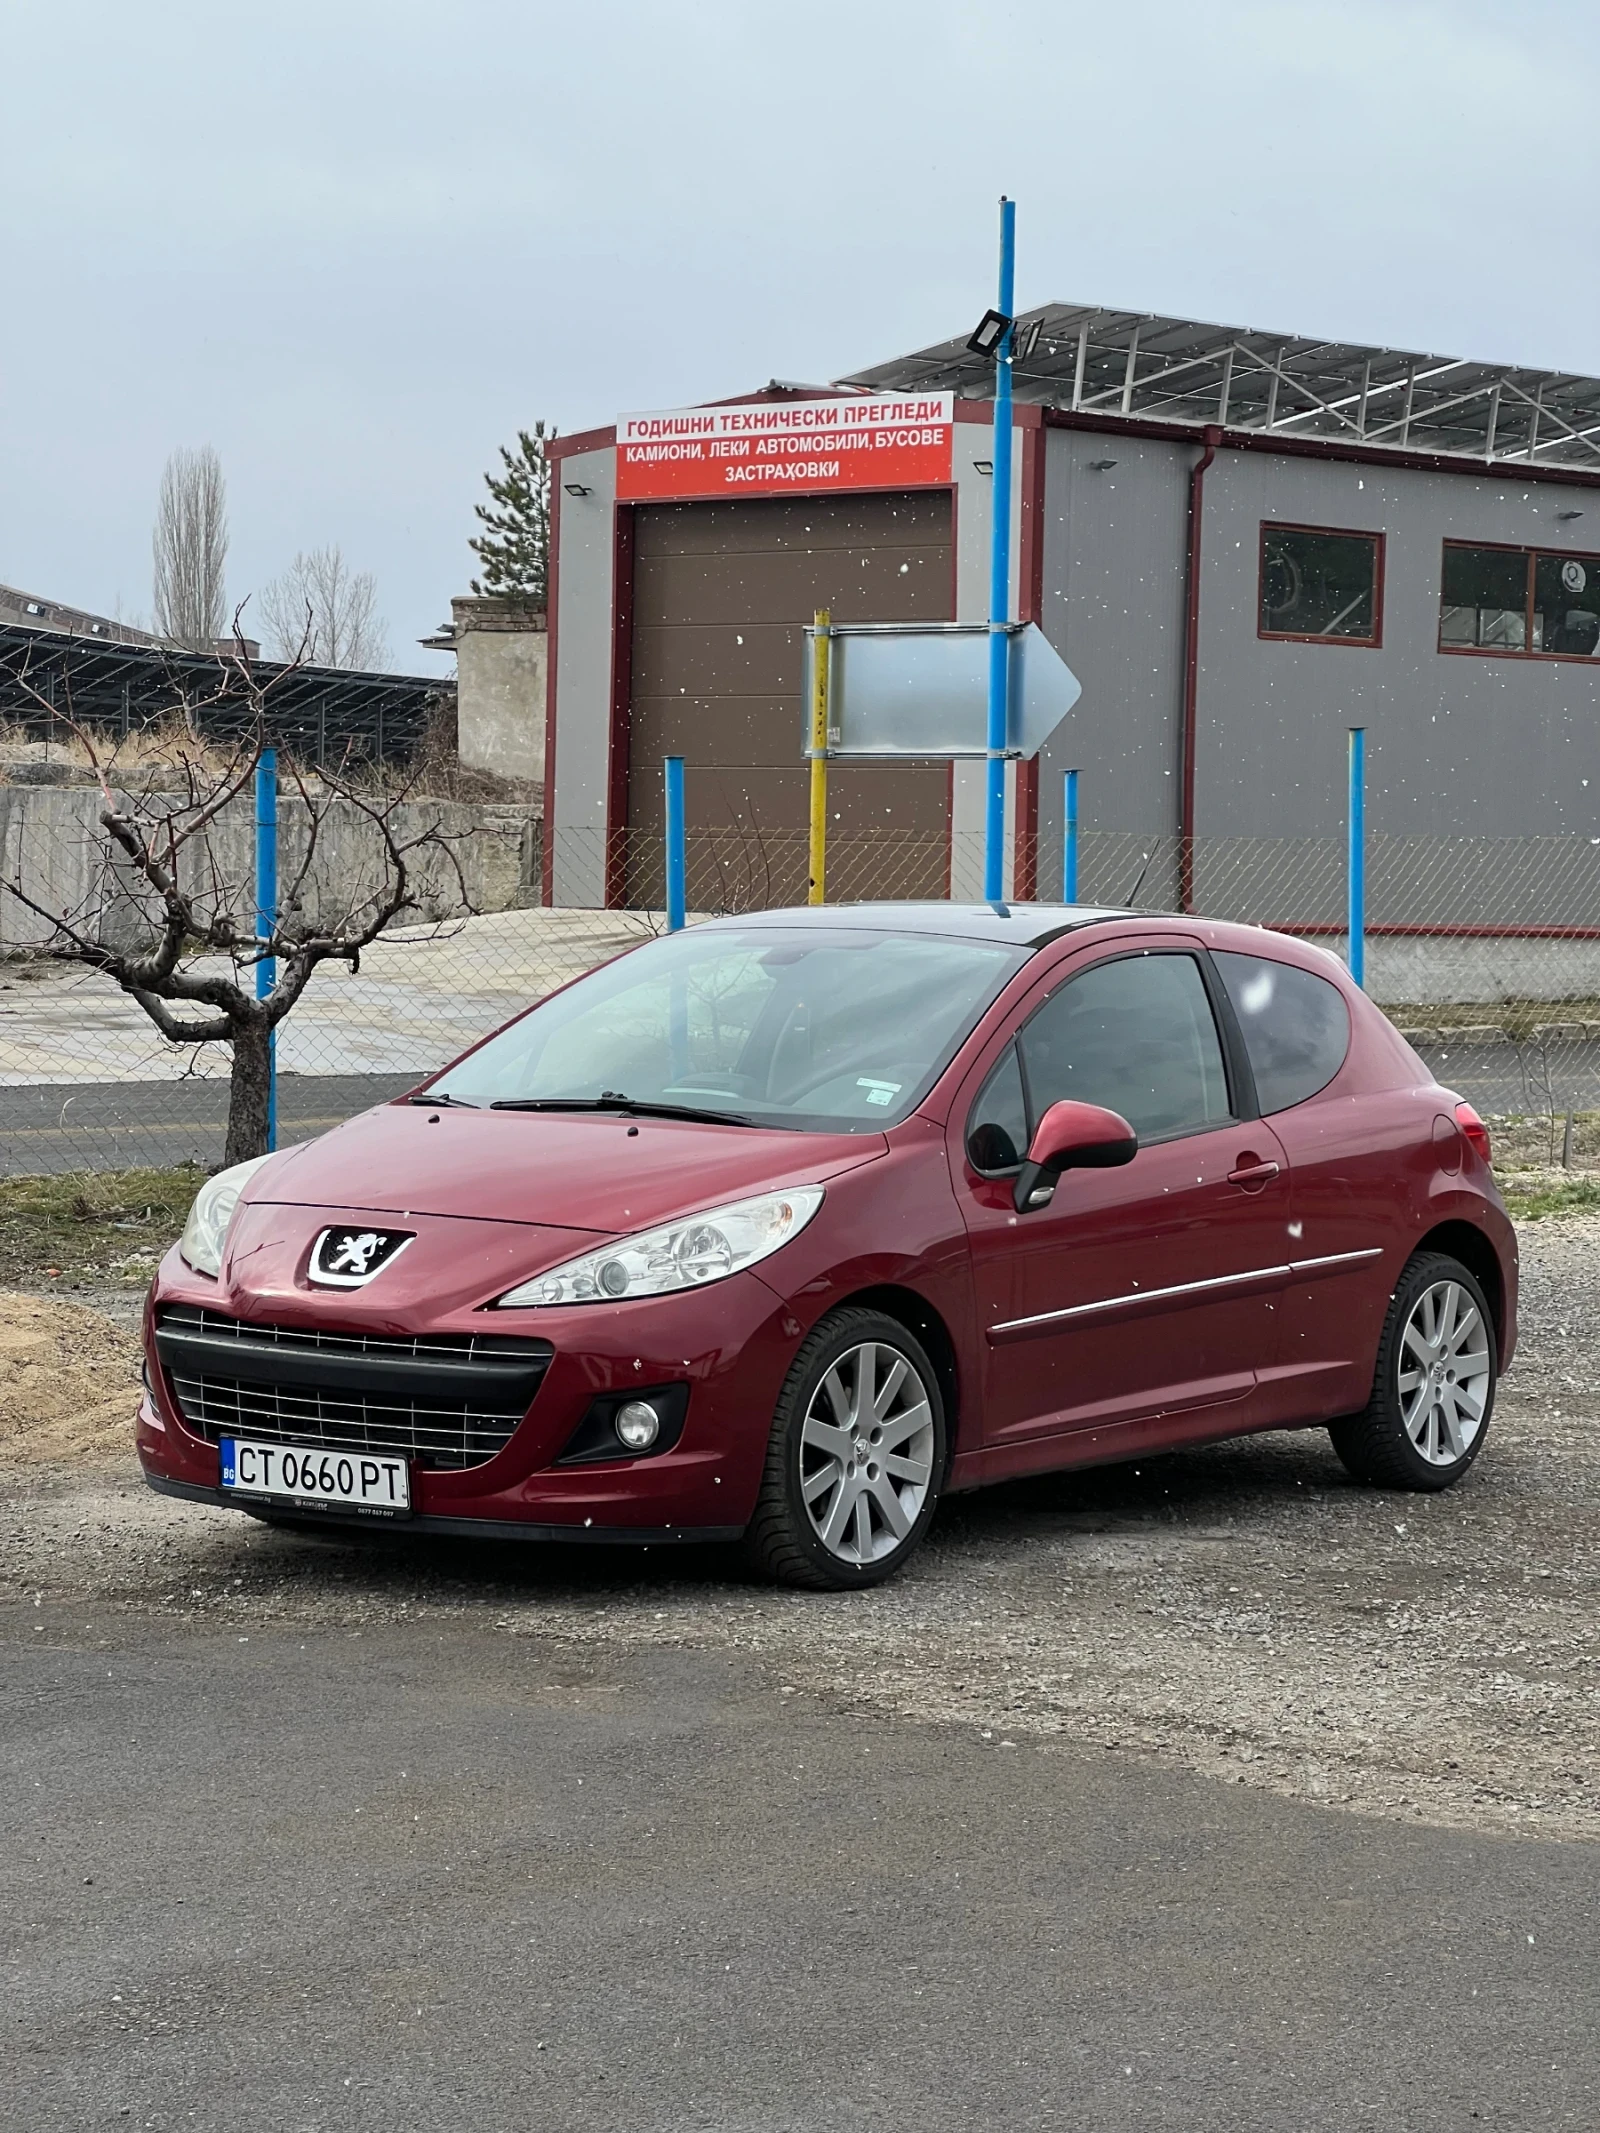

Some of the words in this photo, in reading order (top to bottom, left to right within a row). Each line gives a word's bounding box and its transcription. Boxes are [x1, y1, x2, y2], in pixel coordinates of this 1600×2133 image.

[627, 415, 715, 438] ГОДИШНИ
[720, 408, 838, 431] ТЕХНИЧЕСКИ
[844, 401, 942, 424] ПРЕГЛЕДИ
[626, 441, 705, 462] КАМИОНИ,
[709, 440, 750, 458] ЛЕКИ
[755, 432, 873, 455] АВТОМОБИЛИ,
[875, 428, 944, 448] БУСОВЕ
[724, 460, 840, 482] ЗАСТРАХОВКИ
[223, 1467, 234, 1480] BG
